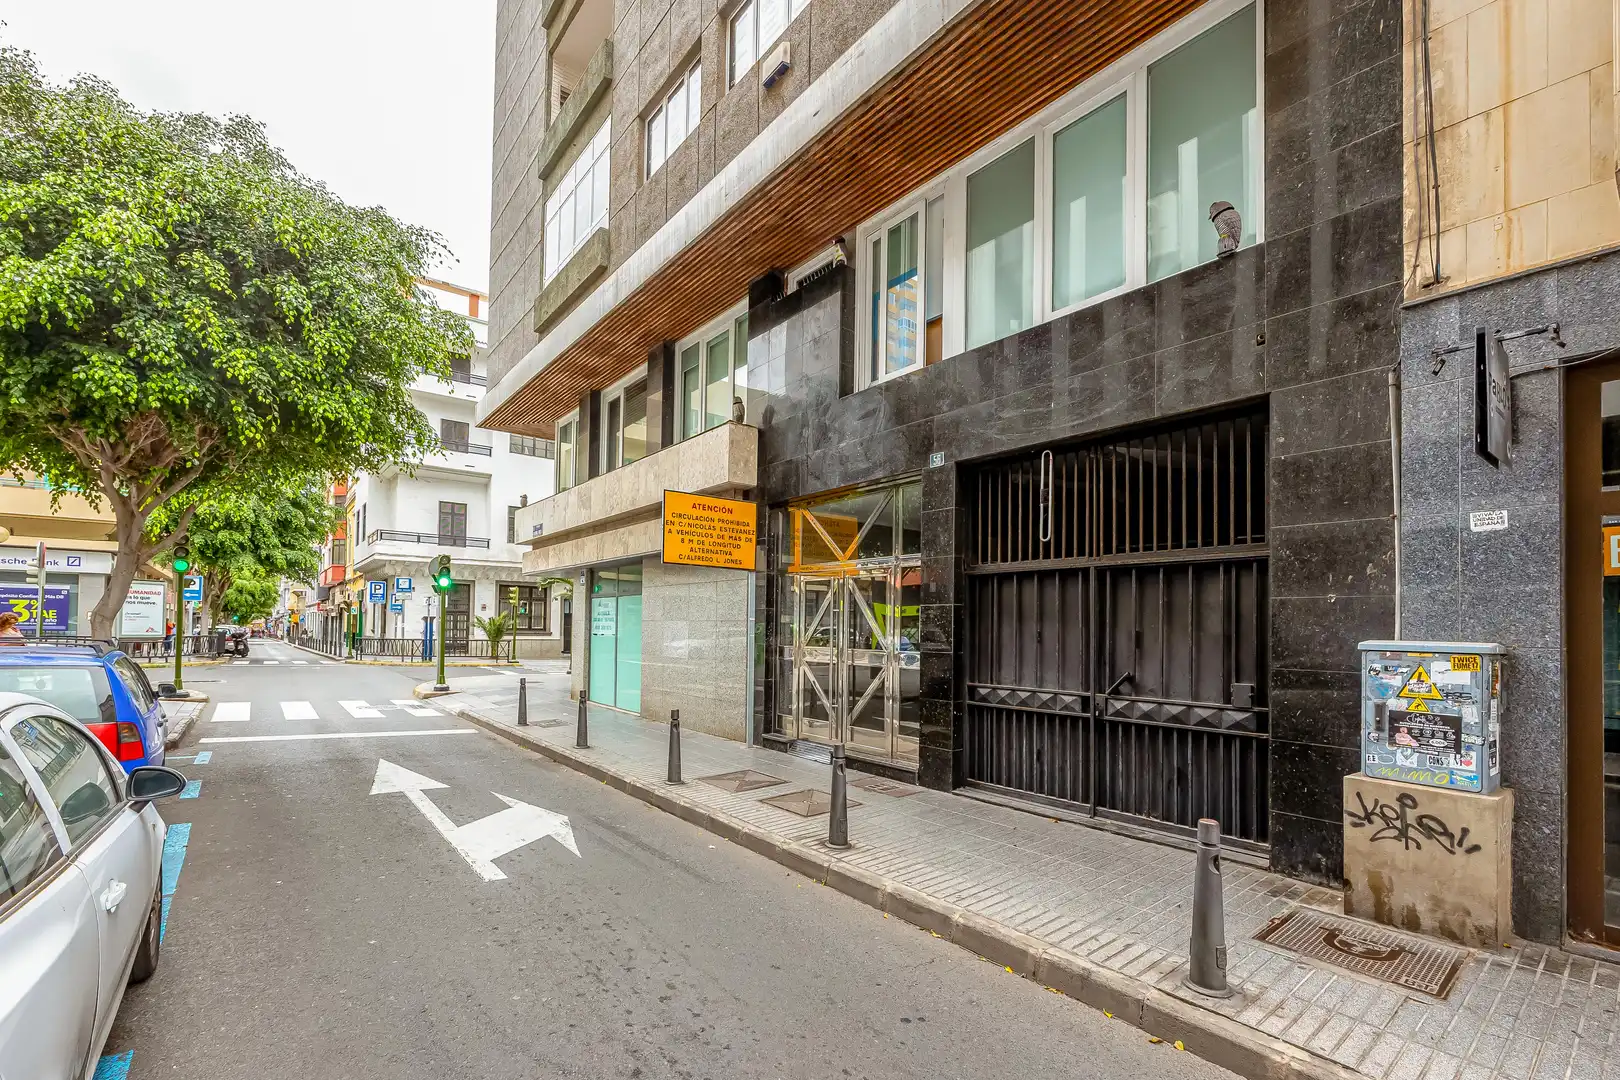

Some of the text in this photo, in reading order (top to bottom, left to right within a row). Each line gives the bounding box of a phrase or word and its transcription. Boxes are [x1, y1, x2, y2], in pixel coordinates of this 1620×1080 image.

[691, 502, 734, 515] ATENCIÓN
[665, 519, 676, 527] EN
[717, 517, 750, 528] PROHIBIDA
[708, 540, 742, 550] LONGITUD
[689, 546, 733, 557] ALTERNATIVA
[678, 553, 714, 563] C/ALFREDO
[374, 584, 382, 594] P
